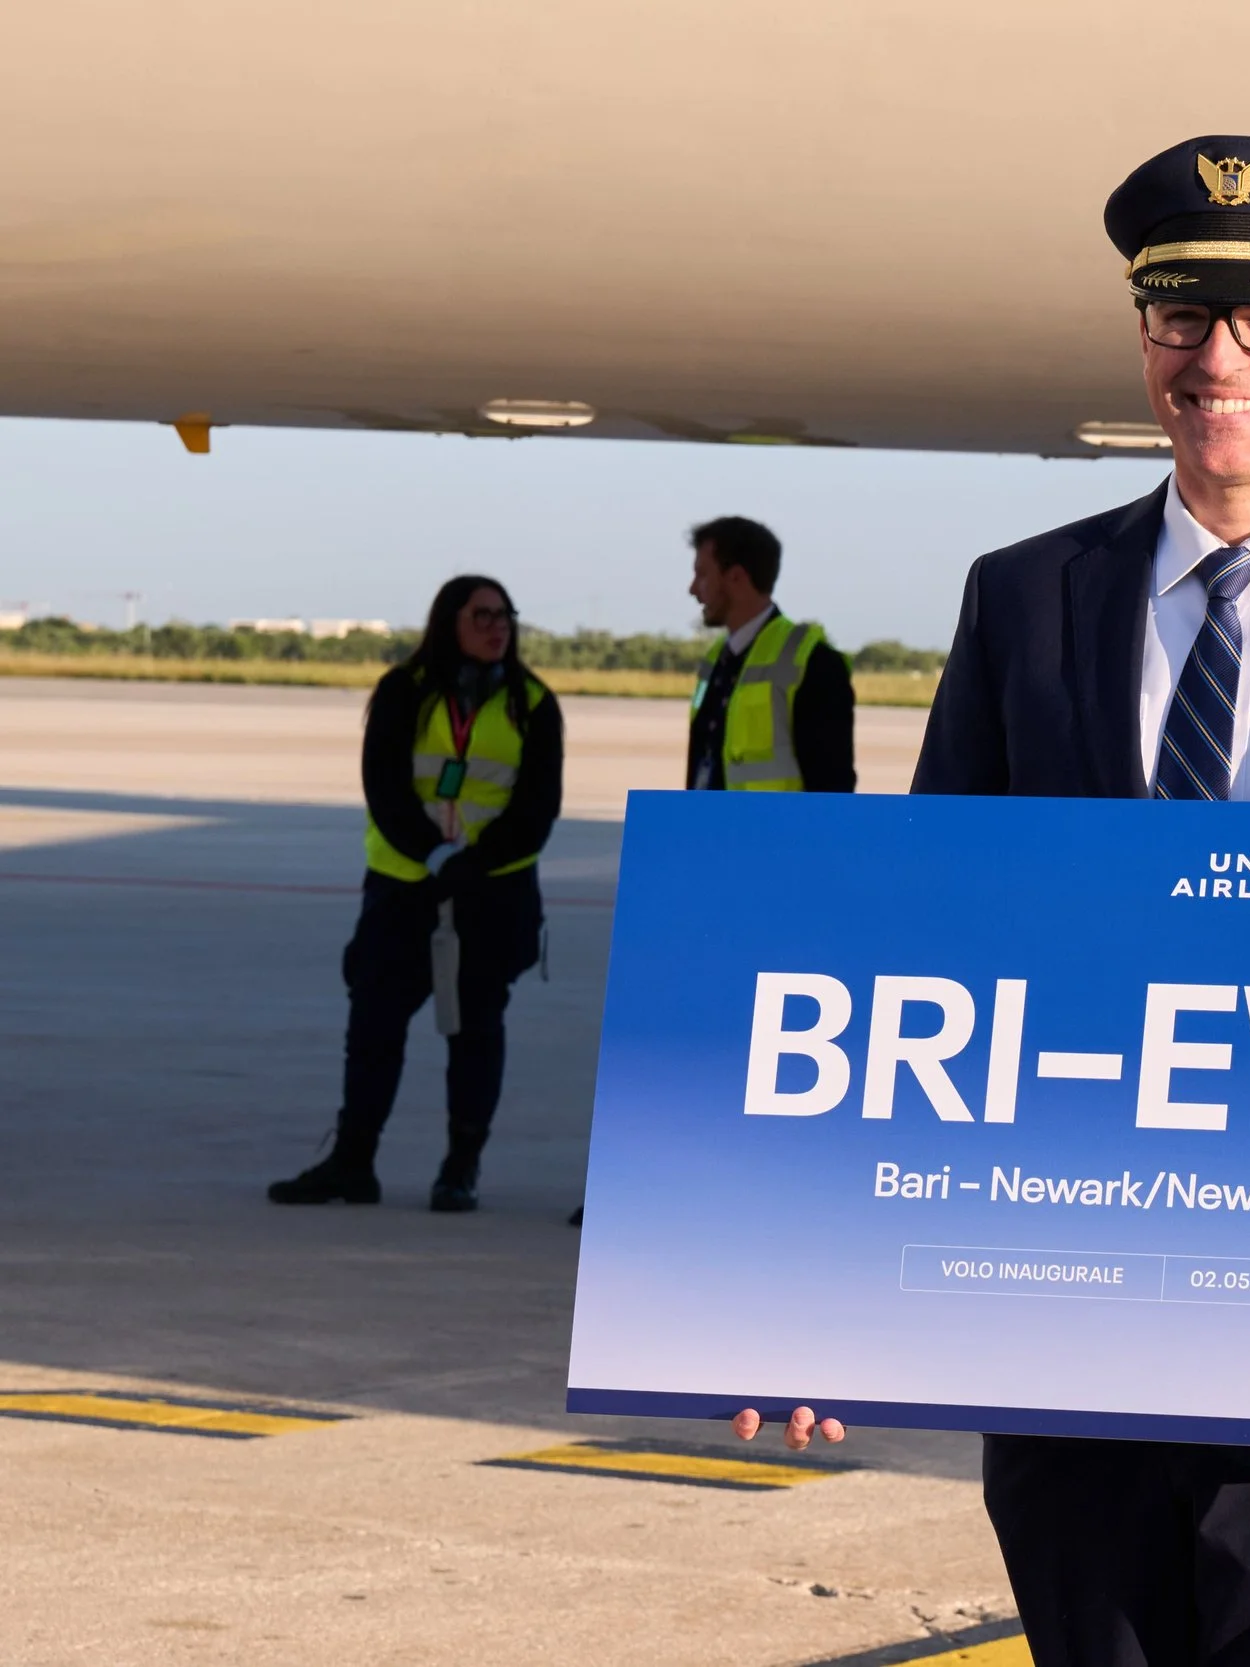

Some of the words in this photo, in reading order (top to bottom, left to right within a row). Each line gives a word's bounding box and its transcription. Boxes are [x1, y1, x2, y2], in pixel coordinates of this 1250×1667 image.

[874, 1161, 951, 1200] Bari
[941, 1260, 994, 1279] VOLO
[999, 1262, 1124, 1284] INAUGURALE
